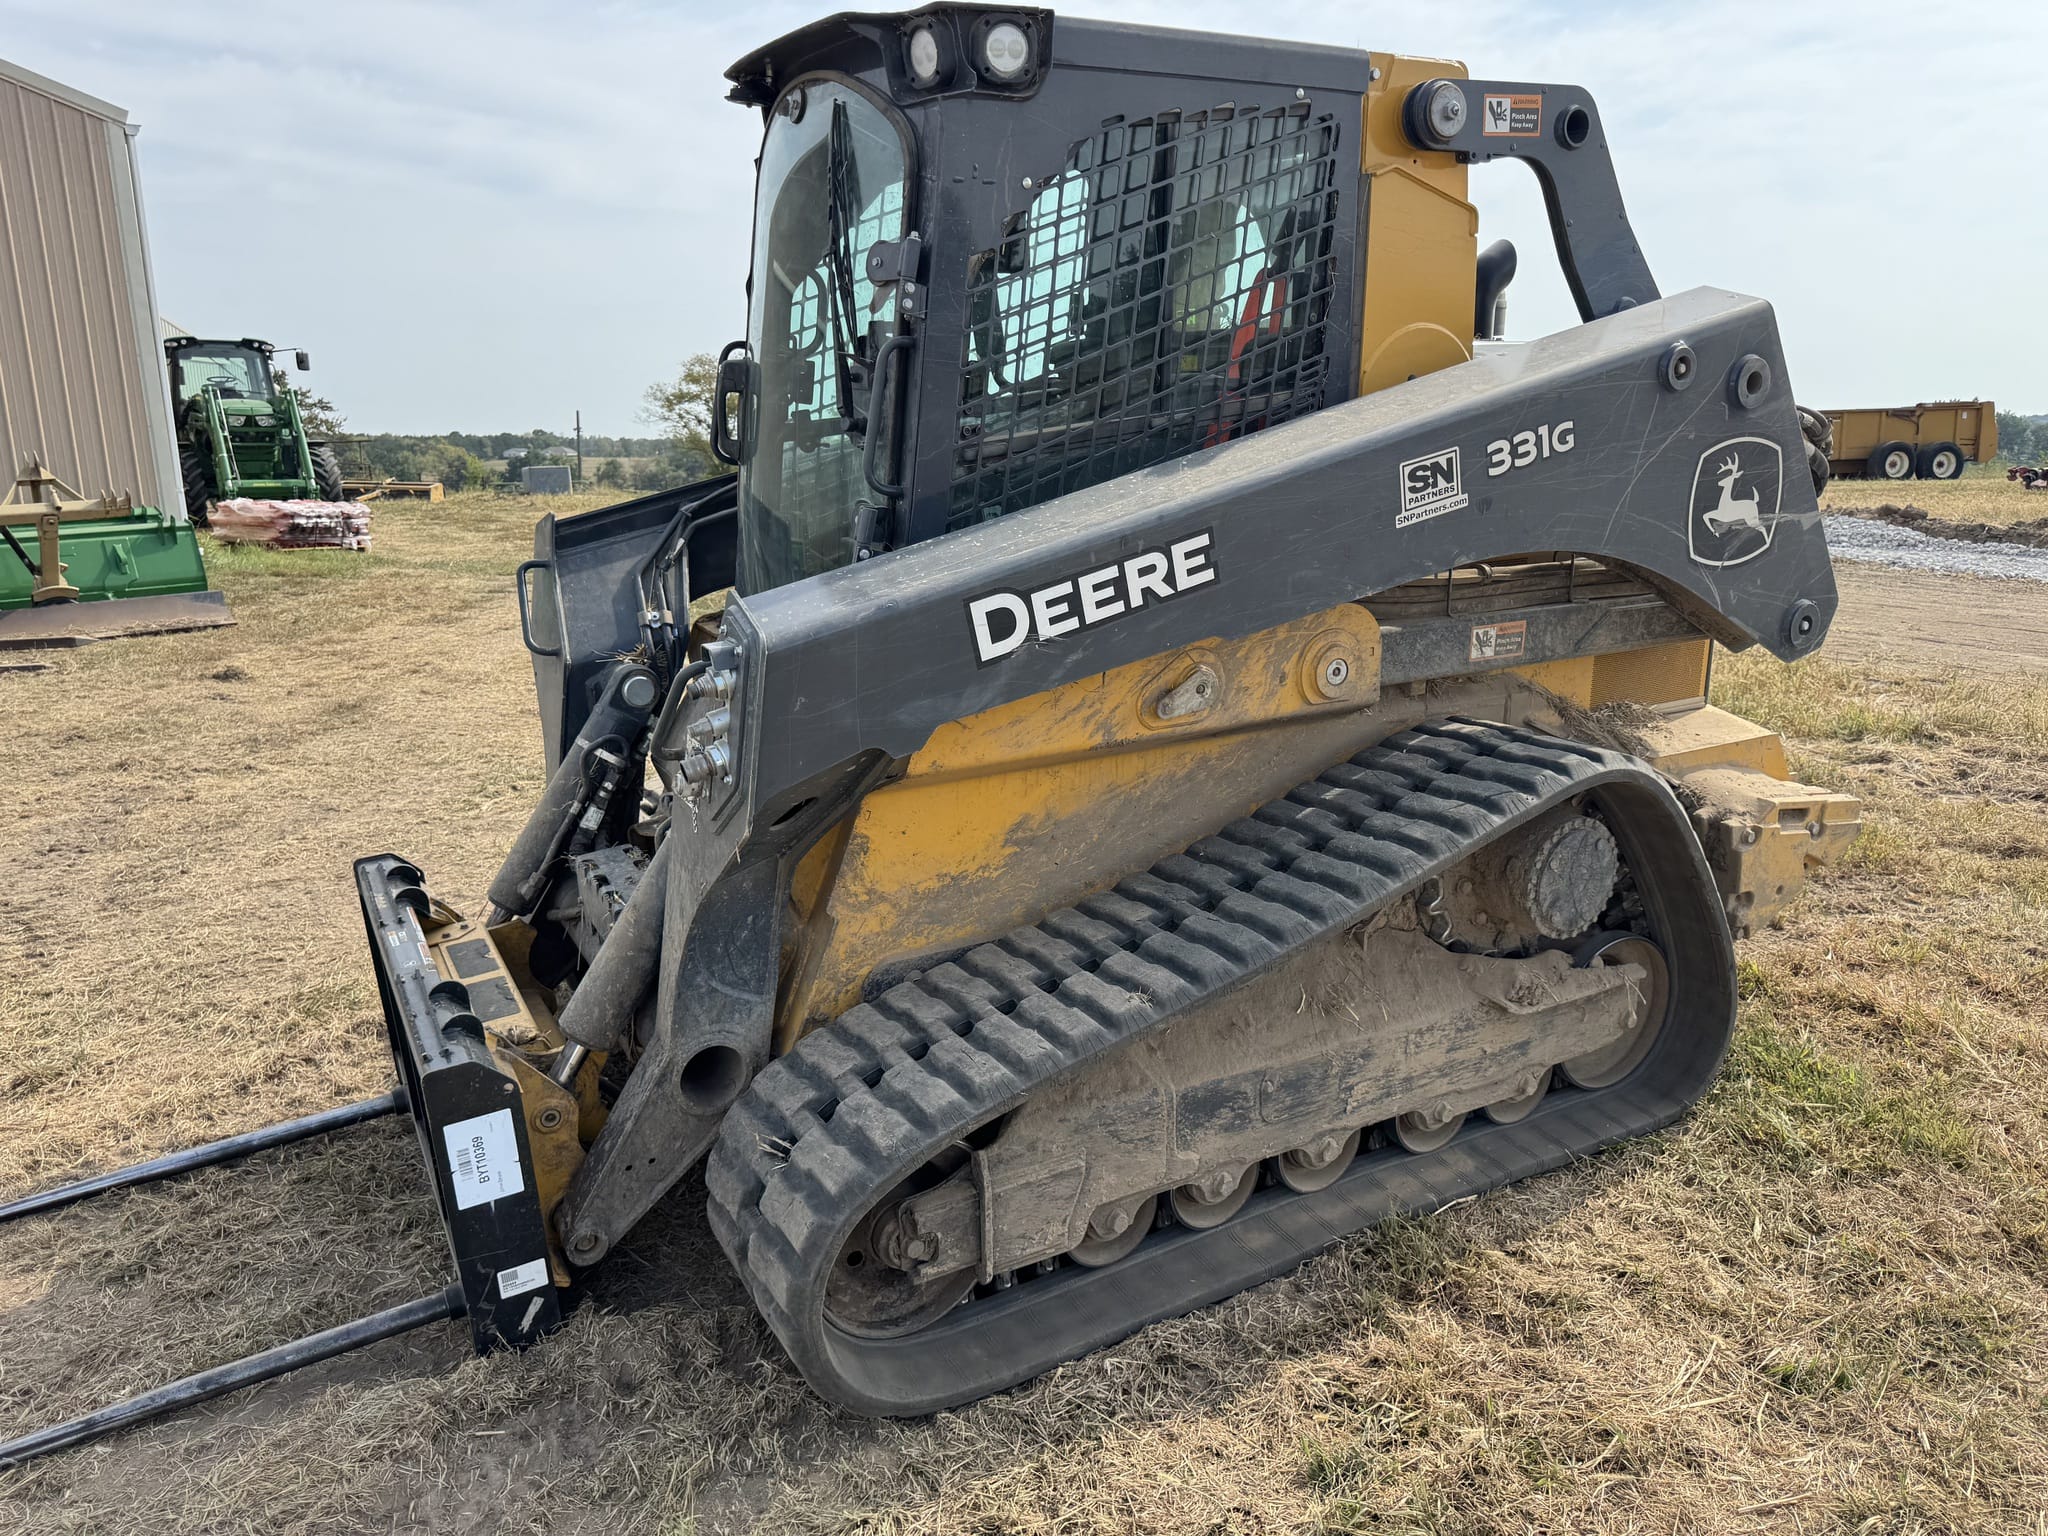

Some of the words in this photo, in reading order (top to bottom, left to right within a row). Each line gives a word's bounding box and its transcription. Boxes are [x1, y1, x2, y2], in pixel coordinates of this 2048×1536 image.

[1486, 421, 1575, 477] 331G
[1397, 497, 1467, 525] SNPartners.com
[1408, 485, 1455, 506] PARTNERS
[969, 533, 1215, 662] DEERE
[471, 1136, 490, 1184] BYT10369
